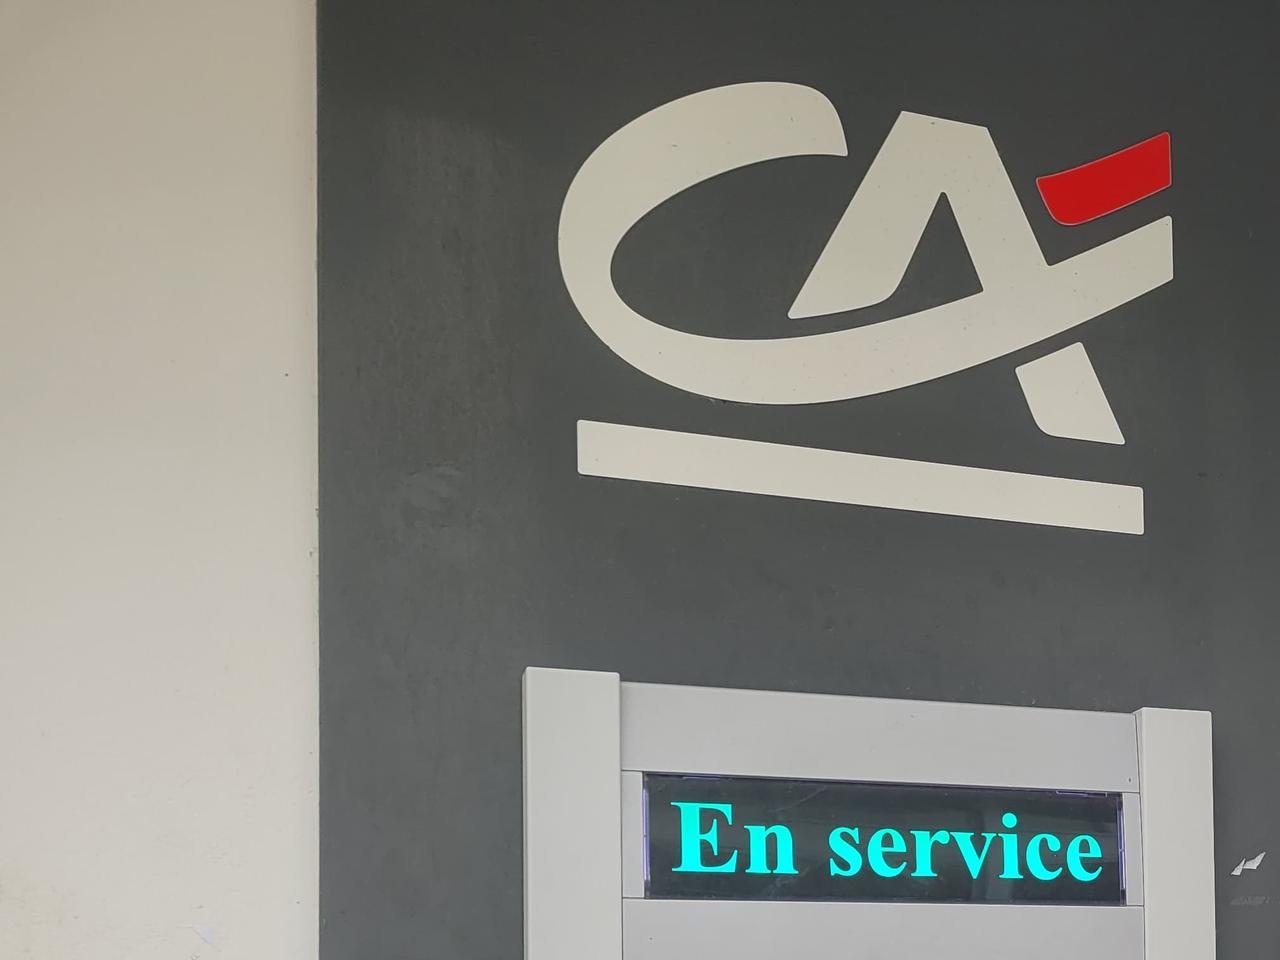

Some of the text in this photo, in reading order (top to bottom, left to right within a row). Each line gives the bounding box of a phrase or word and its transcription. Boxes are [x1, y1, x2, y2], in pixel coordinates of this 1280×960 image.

[558, 82, 1173, 445] CA
[671, 802, 1103, 882] En service
